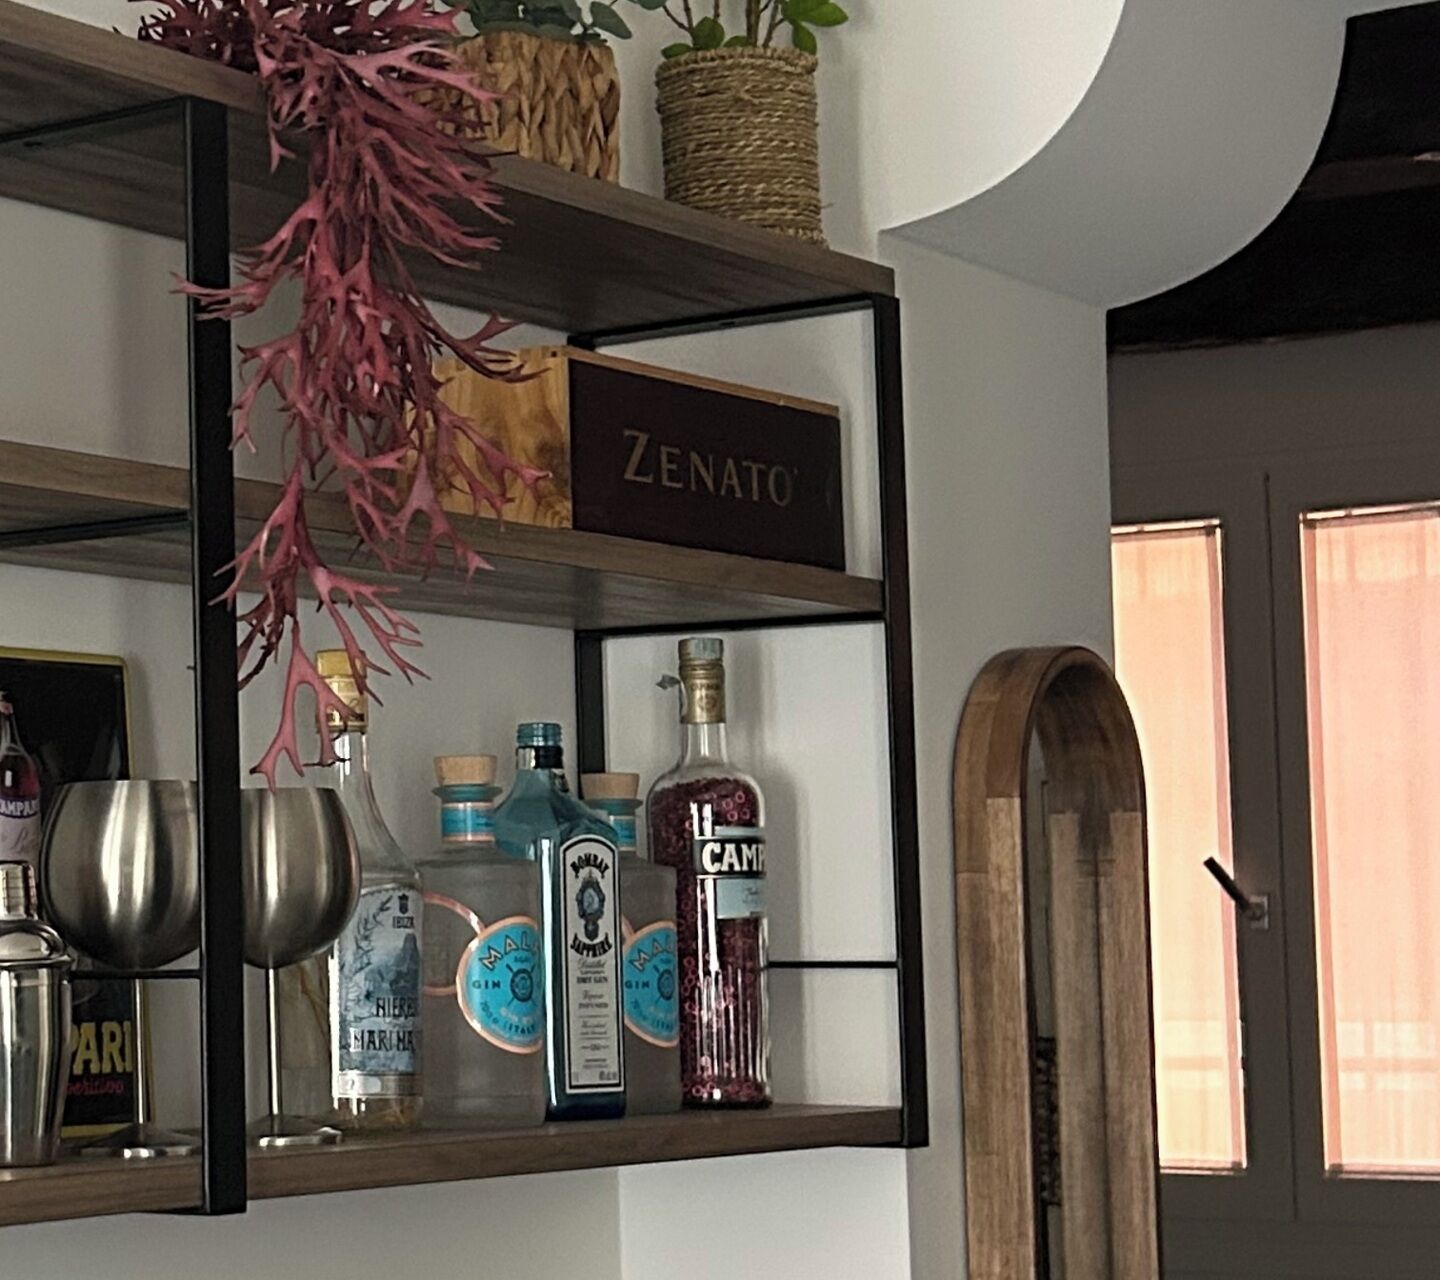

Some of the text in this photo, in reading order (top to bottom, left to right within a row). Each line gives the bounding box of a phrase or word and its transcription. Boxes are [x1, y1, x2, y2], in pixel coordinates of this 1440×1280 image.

[623, 428, 793, 507] ZENATO
[569, 853, 610, 879] BOMBAY
[570, 932, 613, 958] SAPPHIRE
[471, 979, 502, 990] GIN
[624, 980, 650, 990] GIN
